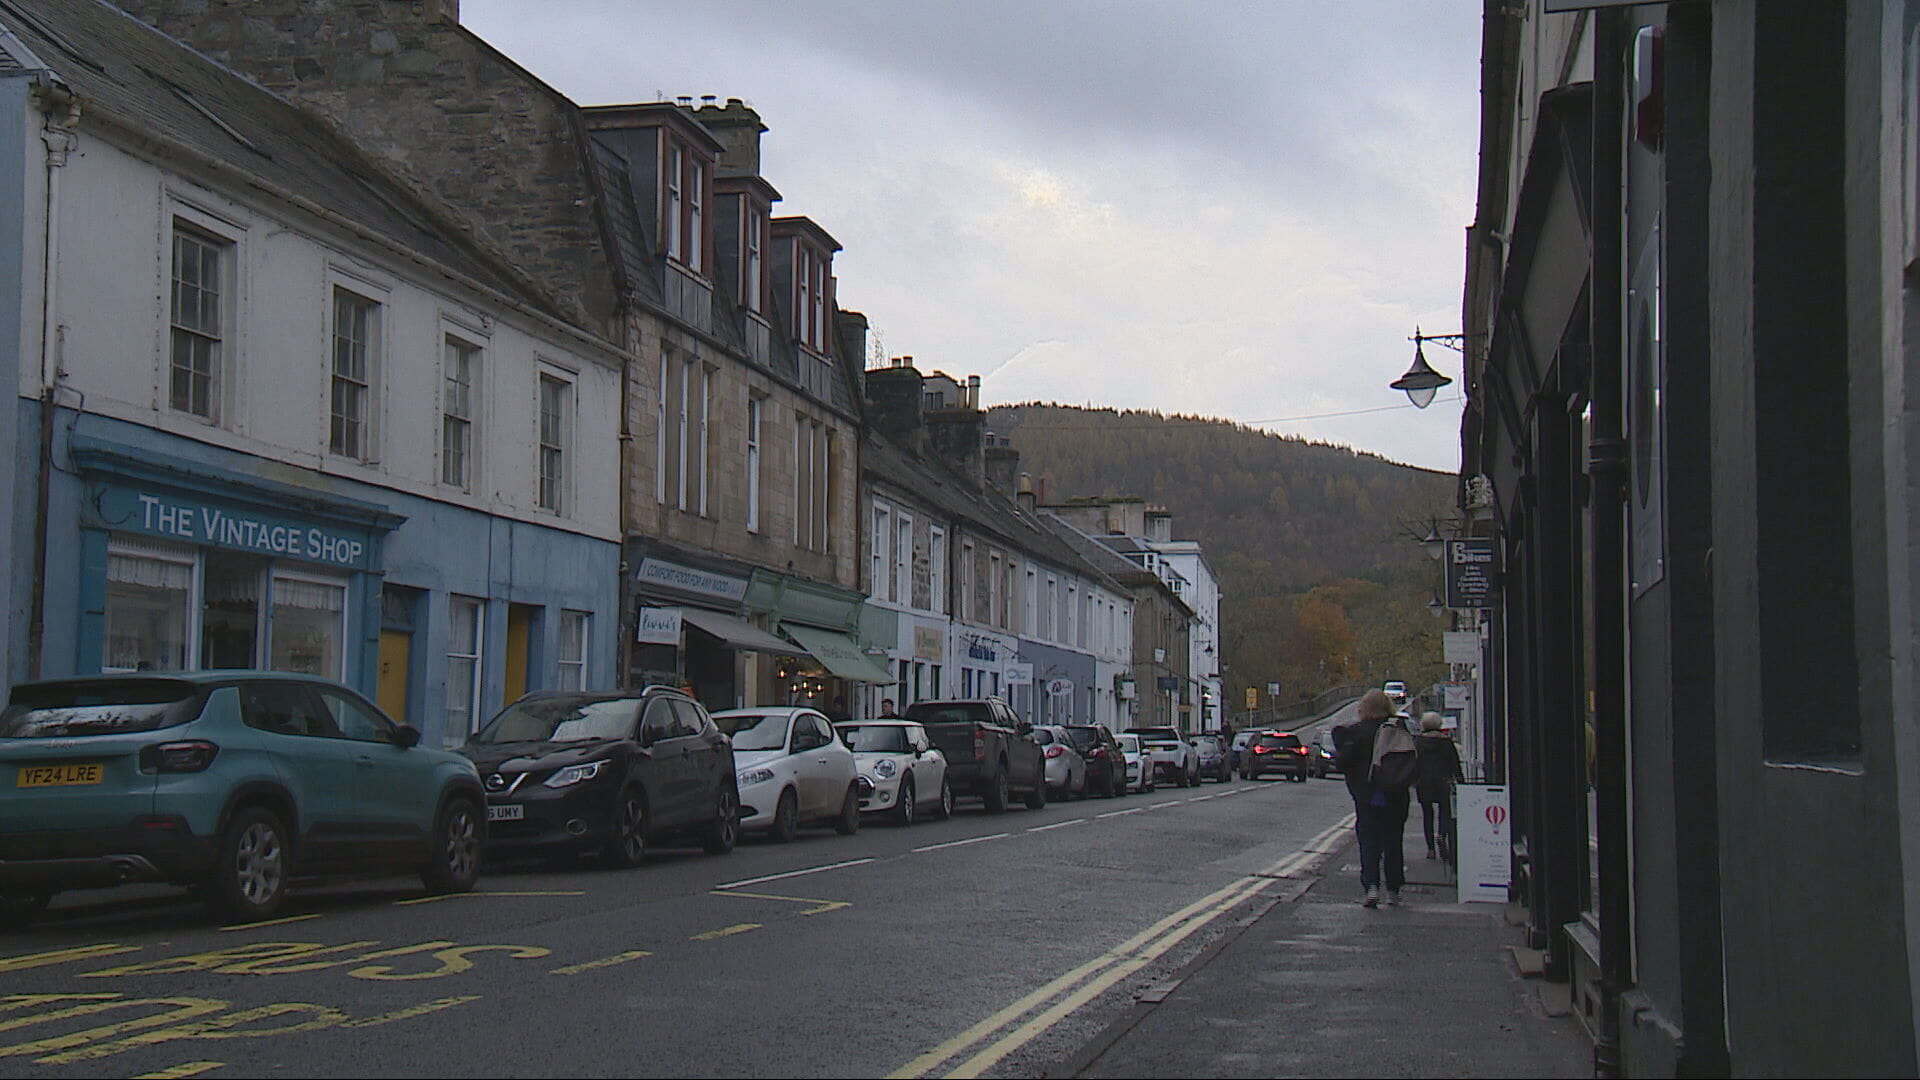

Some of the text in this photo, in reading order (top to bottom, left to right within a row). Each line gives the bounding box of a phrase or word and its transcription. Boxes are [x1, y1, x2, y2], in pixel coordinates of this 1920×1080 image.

[138, 494, 362, 566] THE VINTAGE SHOP
[647, 564, 676, 580] COMFORT
[689, 574, 702, 587] FOR
[25, 766, 97, 784] YF24 LRE
[497, 808, 519, 817] UMY
[76, 940, 551, 980] BUS
